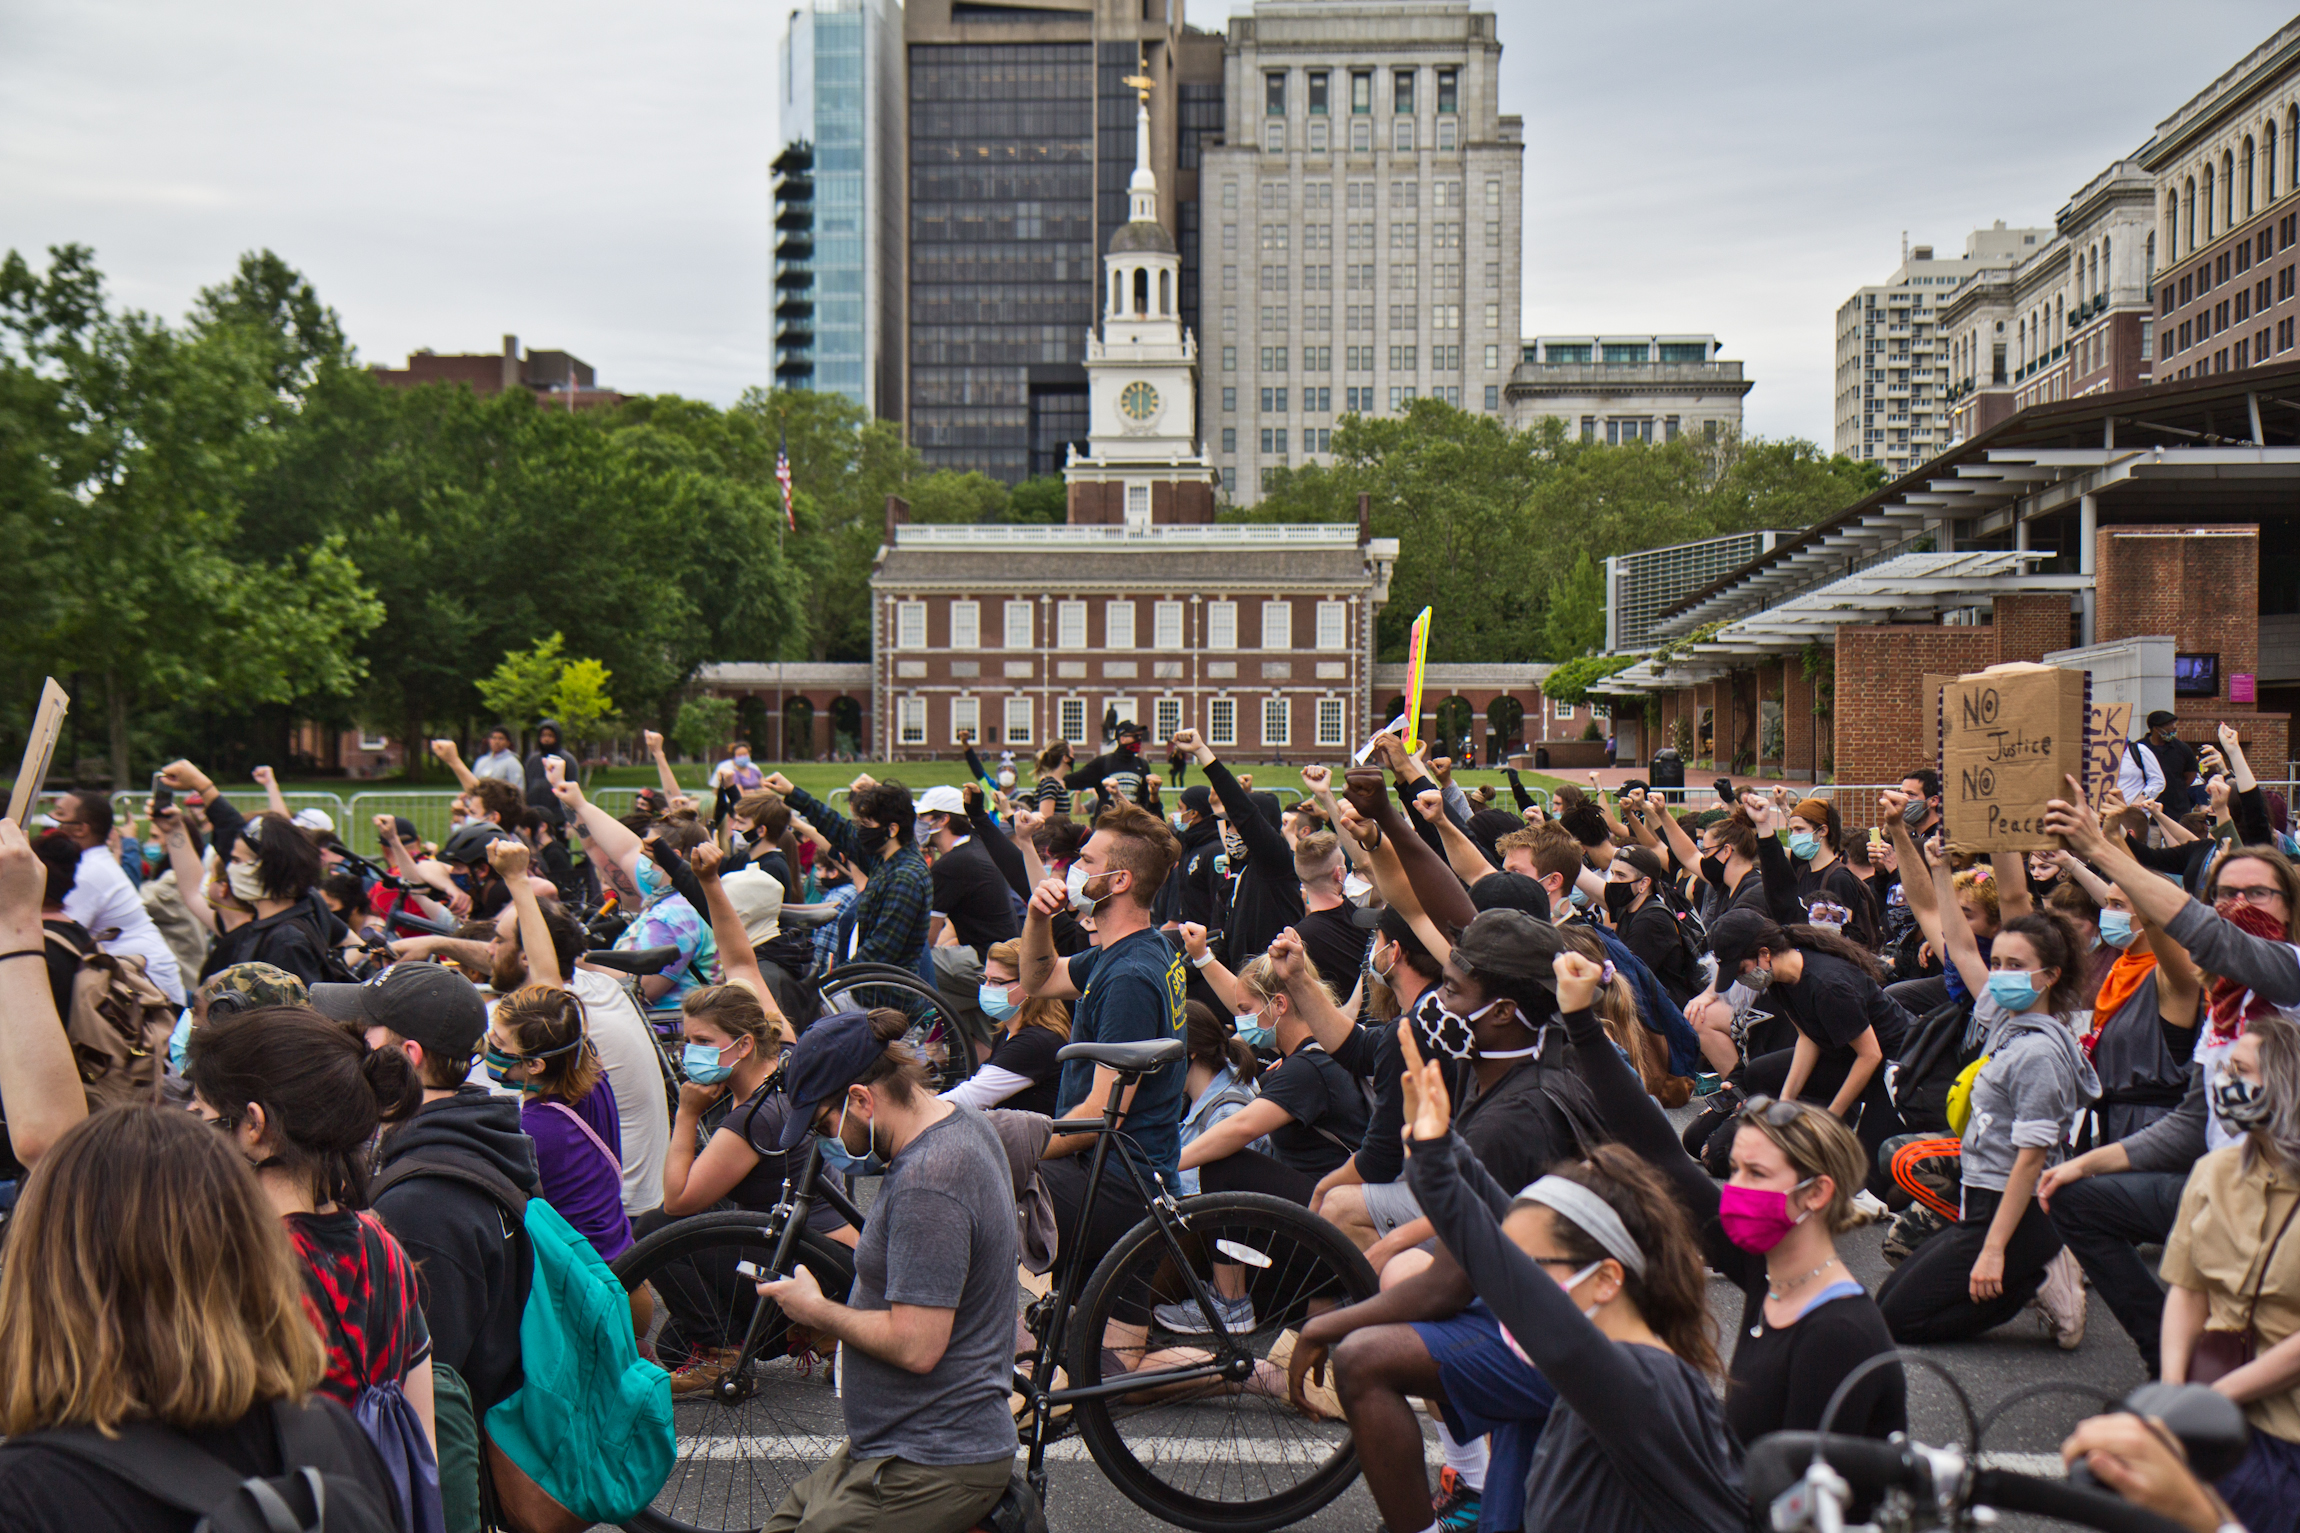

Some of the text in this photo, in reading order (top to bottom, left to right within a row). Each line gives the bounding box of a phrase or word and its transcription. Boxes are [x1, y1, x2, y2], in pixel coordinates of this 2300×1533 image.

[1963, 686, 1999, 729] NO
[2090, 707, 2122, 736] CK
[1986, 728, 2052, 762] Justice
[2090, 738, 2124, 775] ES
[1962, 765, 1996, 801] NO
[1988, 804, 2045, 838] Peace
